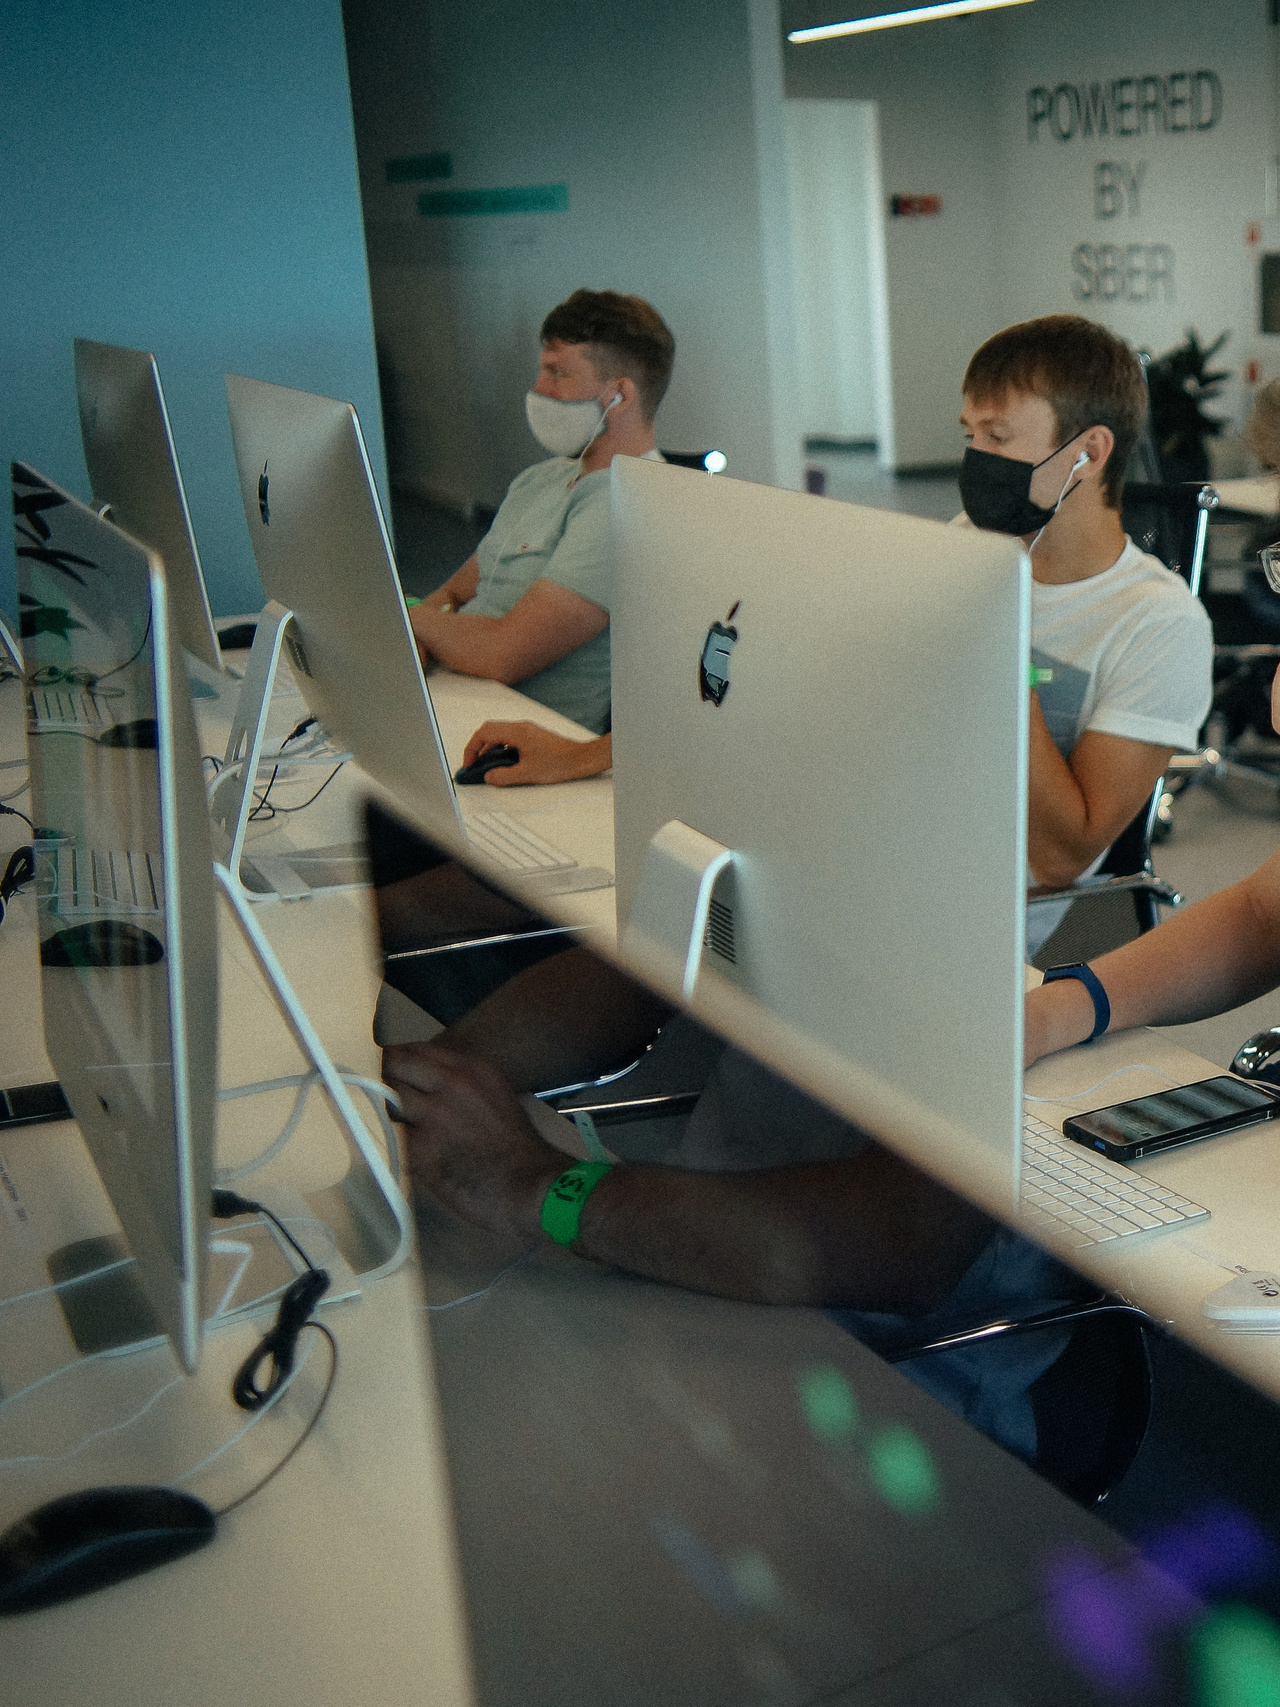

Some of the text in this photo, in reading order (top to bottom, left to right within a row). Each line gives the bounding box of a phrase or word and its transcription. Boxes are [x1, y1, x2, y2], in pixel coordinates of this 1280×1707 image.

[1027, 69, 1223, 142] POWERED
[1094, 160, 1148, 220] BY
[1071, 243, 1175, 301] SBER
